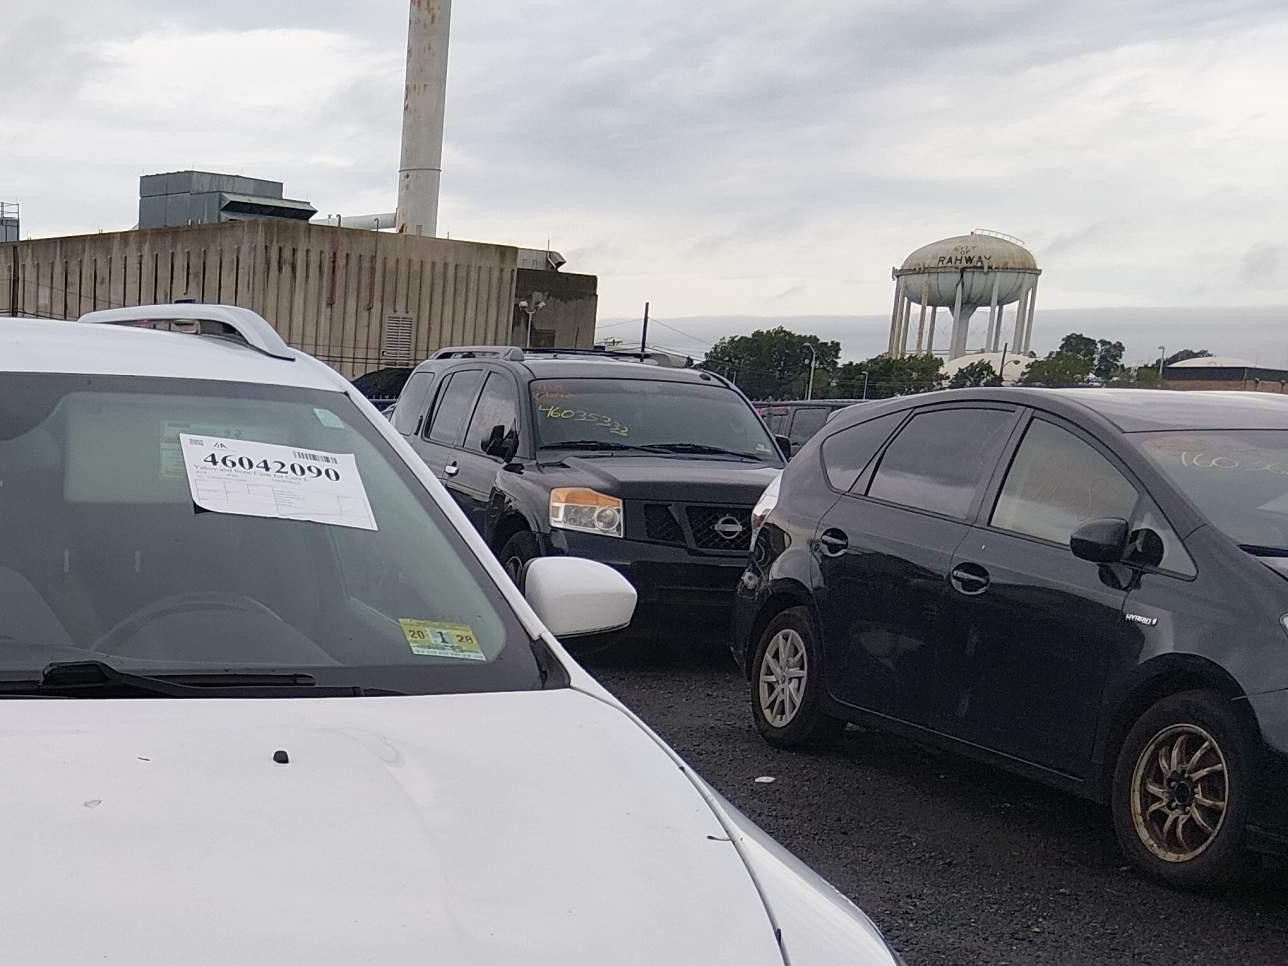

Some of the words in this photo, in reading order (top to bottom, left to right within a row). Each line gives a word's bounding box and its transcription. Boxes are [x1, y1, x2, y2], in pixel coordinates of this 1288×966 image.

[937, 255, 992, 265] RAHWAY
[203, 452, 341, 482] 46042090
[408, 629, 425, 640] 20
[436, 631, 449, 643] 1
